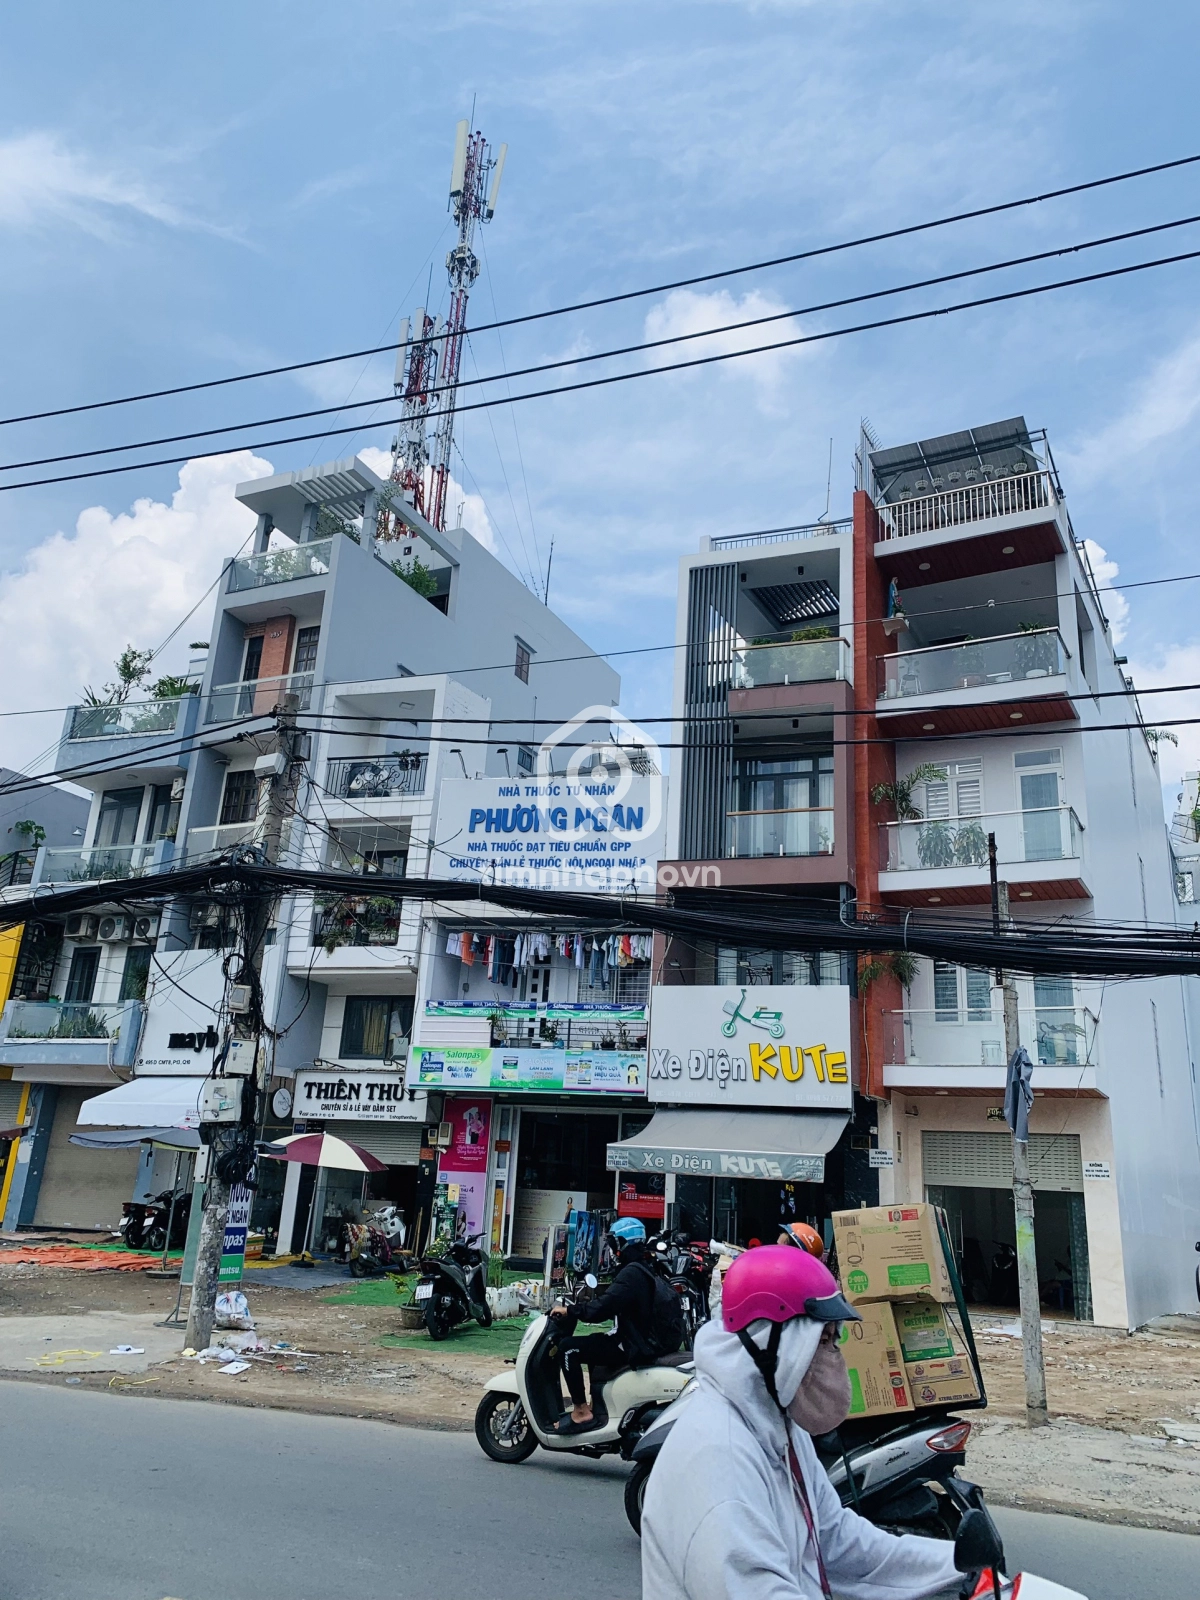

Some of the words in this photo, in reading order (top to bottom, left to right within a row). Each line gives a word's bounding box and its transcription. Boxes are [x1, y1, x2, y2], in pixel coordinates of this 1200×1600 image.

[498, 784, 521, 797] NHÀ
[524, 781, 560, 797] THUỐC
[585, 783, 616, 796] NHÂN
[468, 803, 568, 833] PHƯƠNG
[574, 803, 644, 832] NGÂN
[467, 840, 488, 852] NHÀ
[490, 839, 523, 852] THUỐC
[526, 842, 546, 854] ĐẠT
[549, 841, 571, 852] TIÊU
[573, 838, 607, 852] CHUẨN
[610, 842, 632, 852] GPP
[528, 855, 562, 869] THUỐC
[446, 1050, 481, 1060] Salonpas
[651, 1049, 682, 1080] Xe
[688, 1048, 746, 1088] Điện
[749, 1043, 848, 1083] KUTE
[304, 1078, 362, 1101] THIÊN
[642, 1152, 664, 1167] Xe
[671, 1153, 712, 1172] Điện
[720, 1153, 783, 1178] KUTE
